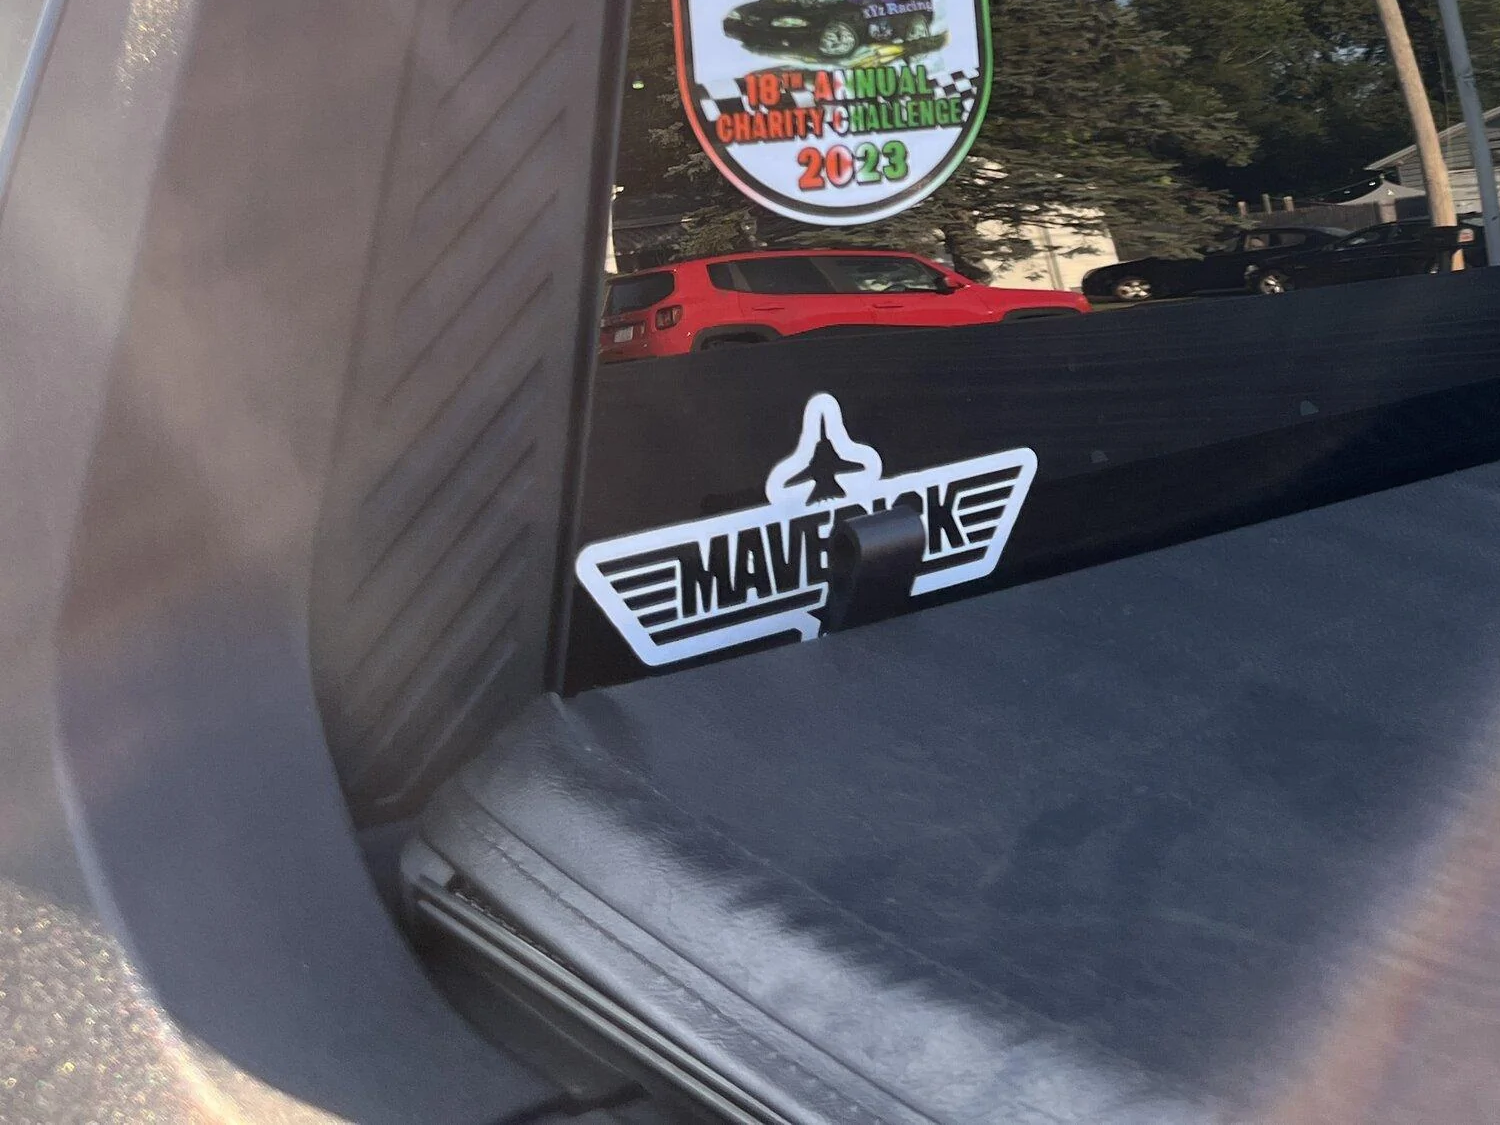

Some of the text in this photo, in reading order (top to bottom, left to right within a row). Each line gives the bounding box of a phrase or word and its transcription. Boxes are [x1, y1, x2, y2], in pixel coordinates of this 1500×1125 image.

[813, 64, 934, 102] ANNUAL
[715, 96, 963, 144] CHARITY CHALLENGE
[796, 139, 909, 191] 2023
[677, 484, 965, 618] MAVEK
